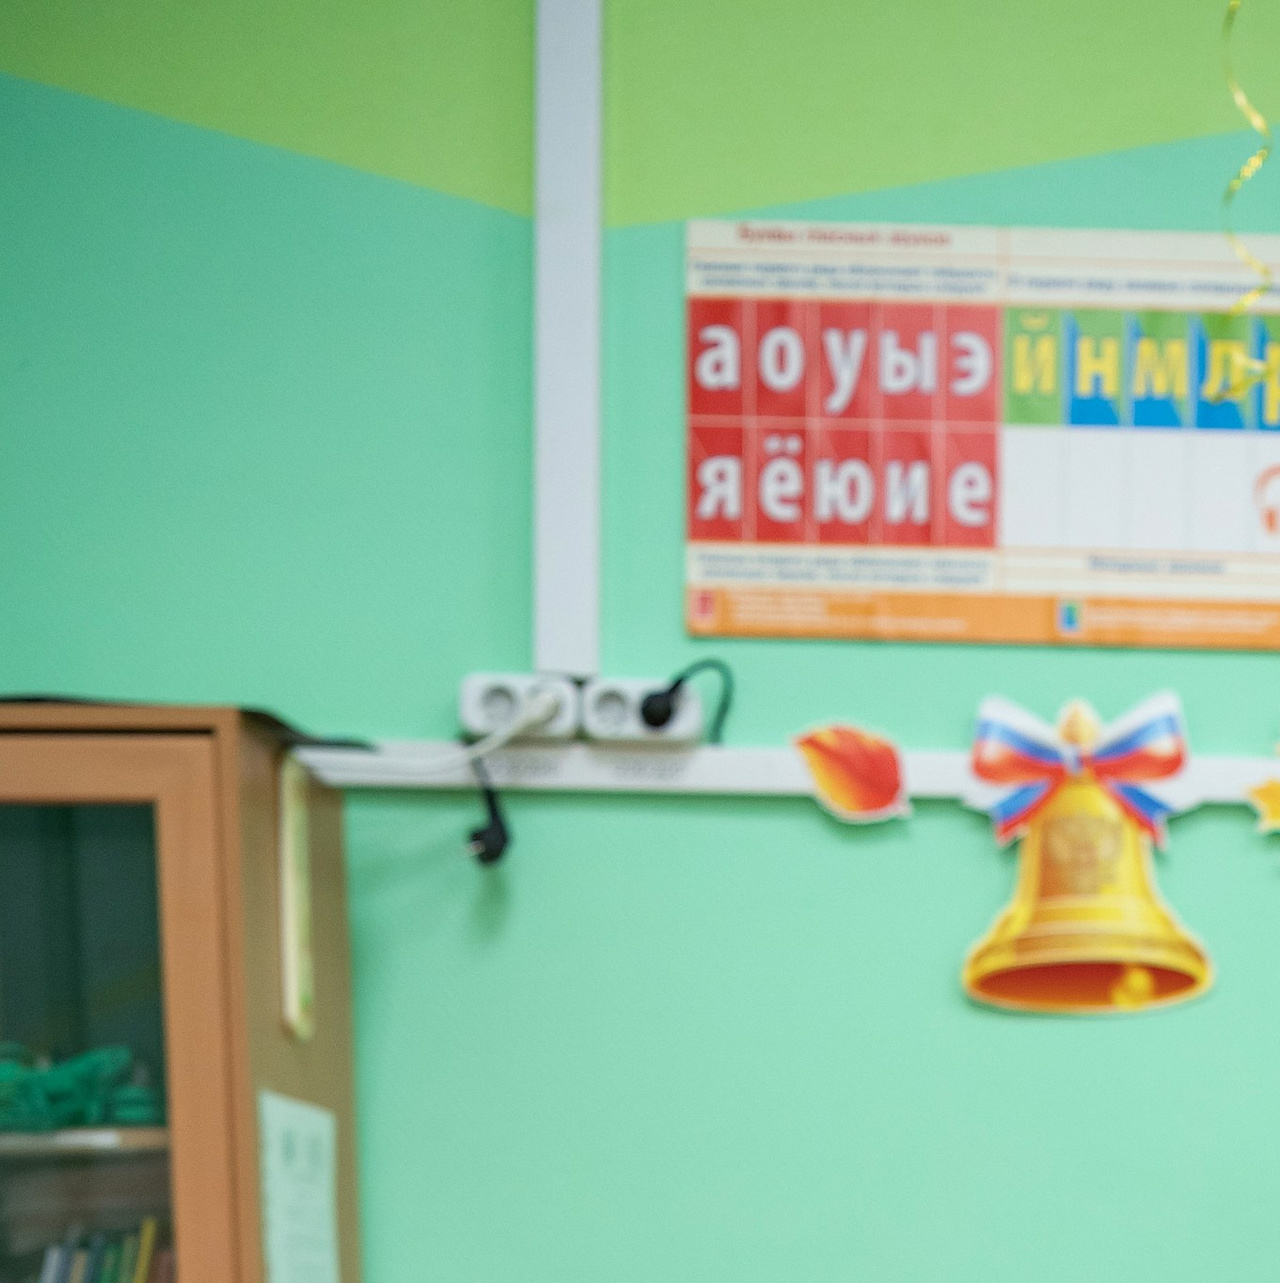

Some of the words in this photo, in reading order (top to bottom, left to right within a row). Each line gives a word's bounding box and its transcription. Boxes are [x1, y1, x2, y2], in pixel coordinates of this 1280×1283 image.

[697, 326, 740, 389] а
[758, 327, 806, 391] о
[822, 328, 869, 415] у
[879, 332, 938, 395] ы
[950, 331, 993, 396] э
[1011, 312, 1057, 395] й
[1077, 335, 1120, 395] н
[1133, 338, 1187, 398] м
[697, 457, 743, 520] я
[760, 434, 803, 522] ё
[812, 458, 873, 524] ю
[885, 460, 930, 525] и
[948, 461, 993, 526] е
